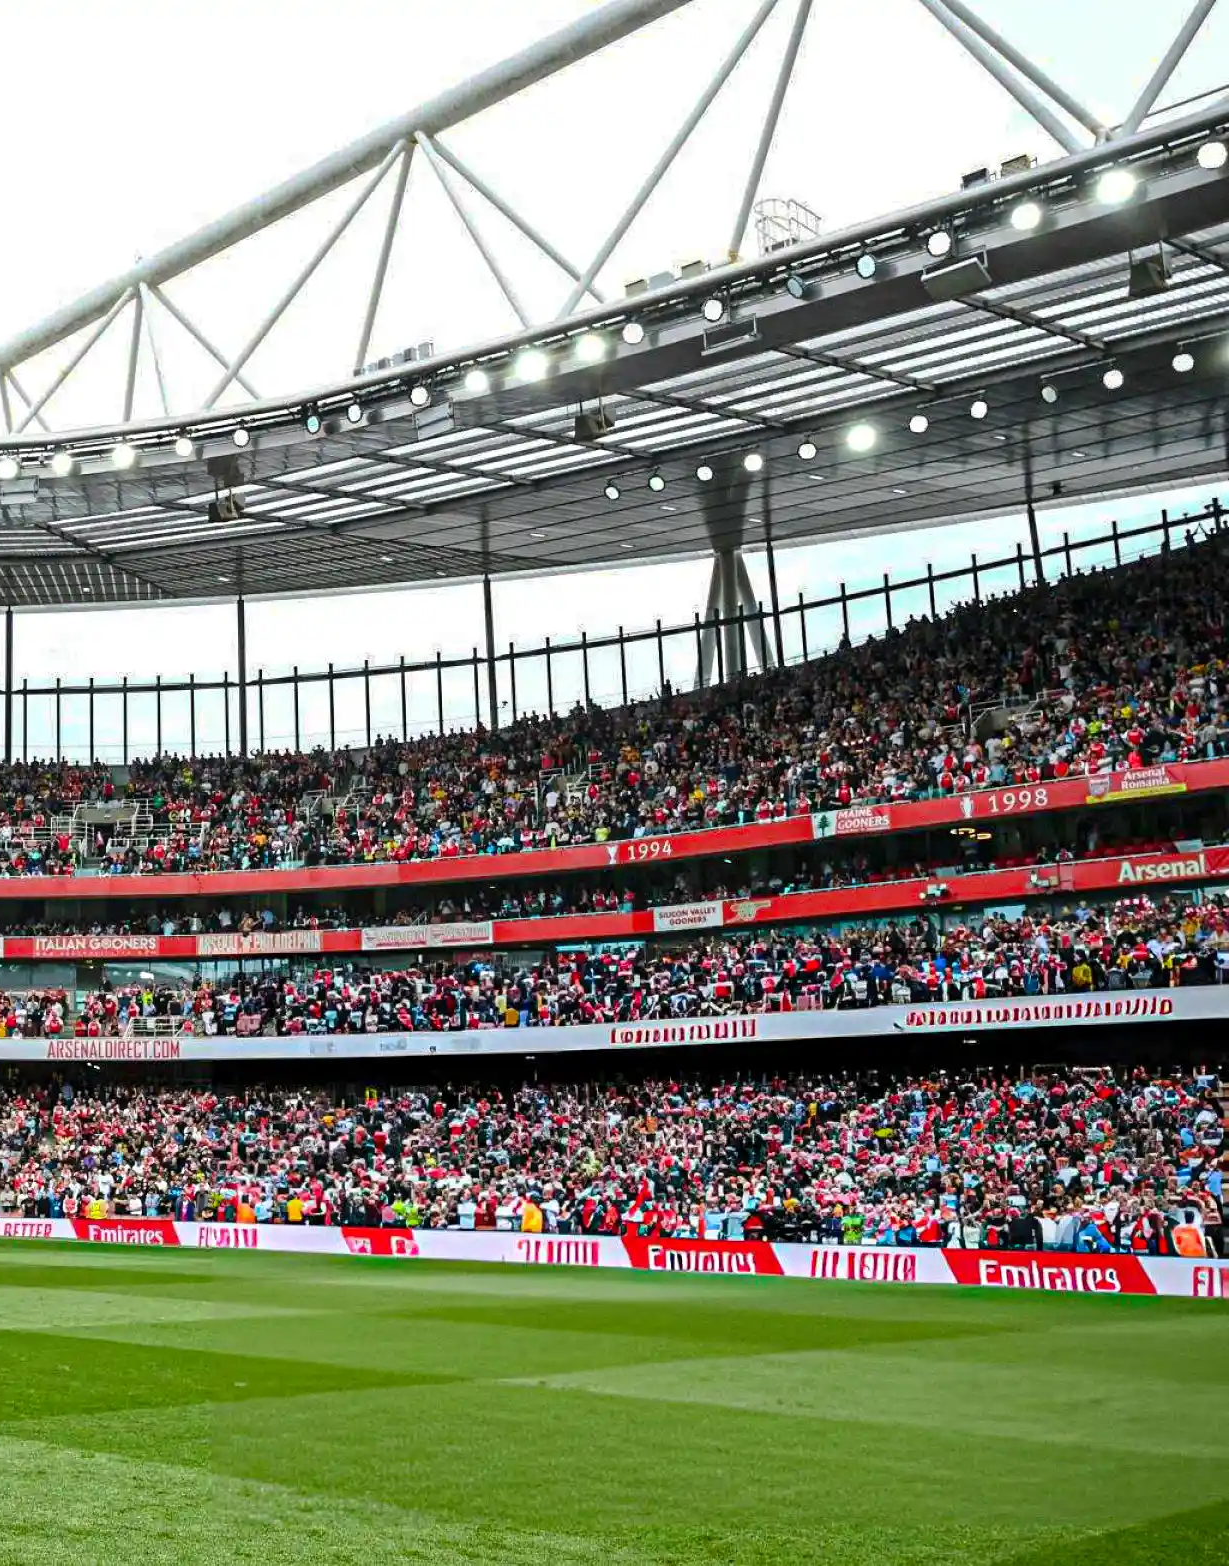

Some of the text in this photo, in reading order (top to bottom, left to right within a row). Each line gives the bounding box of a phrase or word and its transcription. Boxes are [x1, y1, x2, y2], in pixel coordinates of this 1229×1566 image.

[1124, 766, 1166, 781] Arsenal
[1120, 777, 1170, 790] Romania
[987, 787, 1049, 814] 1998
[837, 807, 873, 819] MAINE
[838, 815, 889, 830] GOONERS
[627, 838, 673, 860] 1994
[1118, 854, 1206, 883] Arsenal
[690, 906, 717, 915] VALLEY
[669, 916, 707, 926] GOONERS
[35, 936, 157, 950] ITALIAN GOONERS
[47, 1039, 180, 1059] ARSENALDIRECT.COM
[3, 1222, 52, 1238] BETTER
[87, 1224, 164, 1245] Emirates
[978, 1259, 1122, 1293] Emirates
